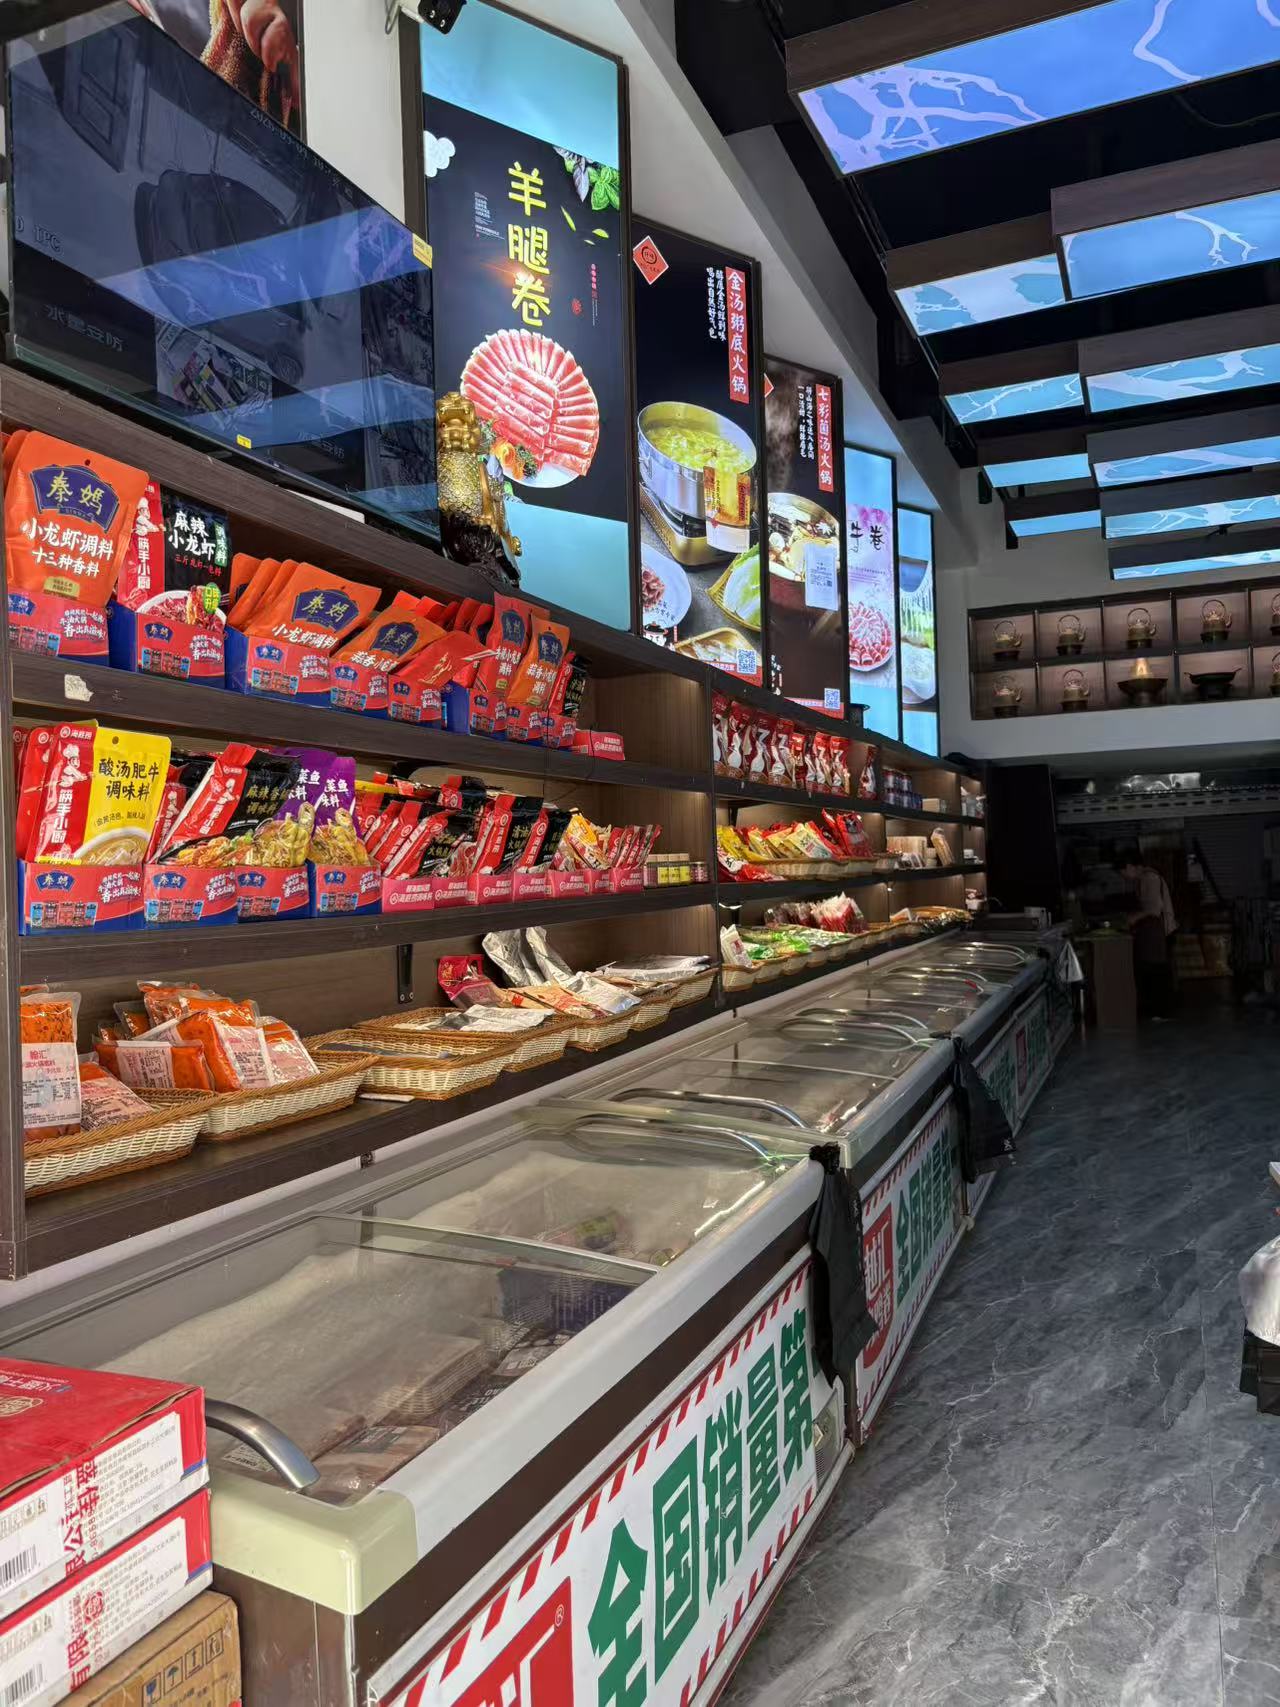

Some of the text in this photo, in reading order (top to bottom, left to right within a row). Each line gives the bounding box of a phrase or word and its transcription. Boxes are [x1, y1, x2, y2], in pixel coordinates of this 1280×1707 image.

[508, 161, 551, 327] 羊腿卷
[728, 272, 747, 395] 金汤粥底火锅
[817, 388, 832, 485] 七彩菌汤火锅
[21, 517, 114, 560] 小龙虾调料
[168, 529, 216, 561] 小龙虾
[174, 510, 209, 538] 麻辣
[32, 547, 100, 578] 十三种香料
[137, 537, 150, 589] 筷手小厨
[98, 758, 160, 783] 酸汤肥牛
[106, 780, 151, 802] 调味料
[52, 790, 73, 844] 筷手小厨
